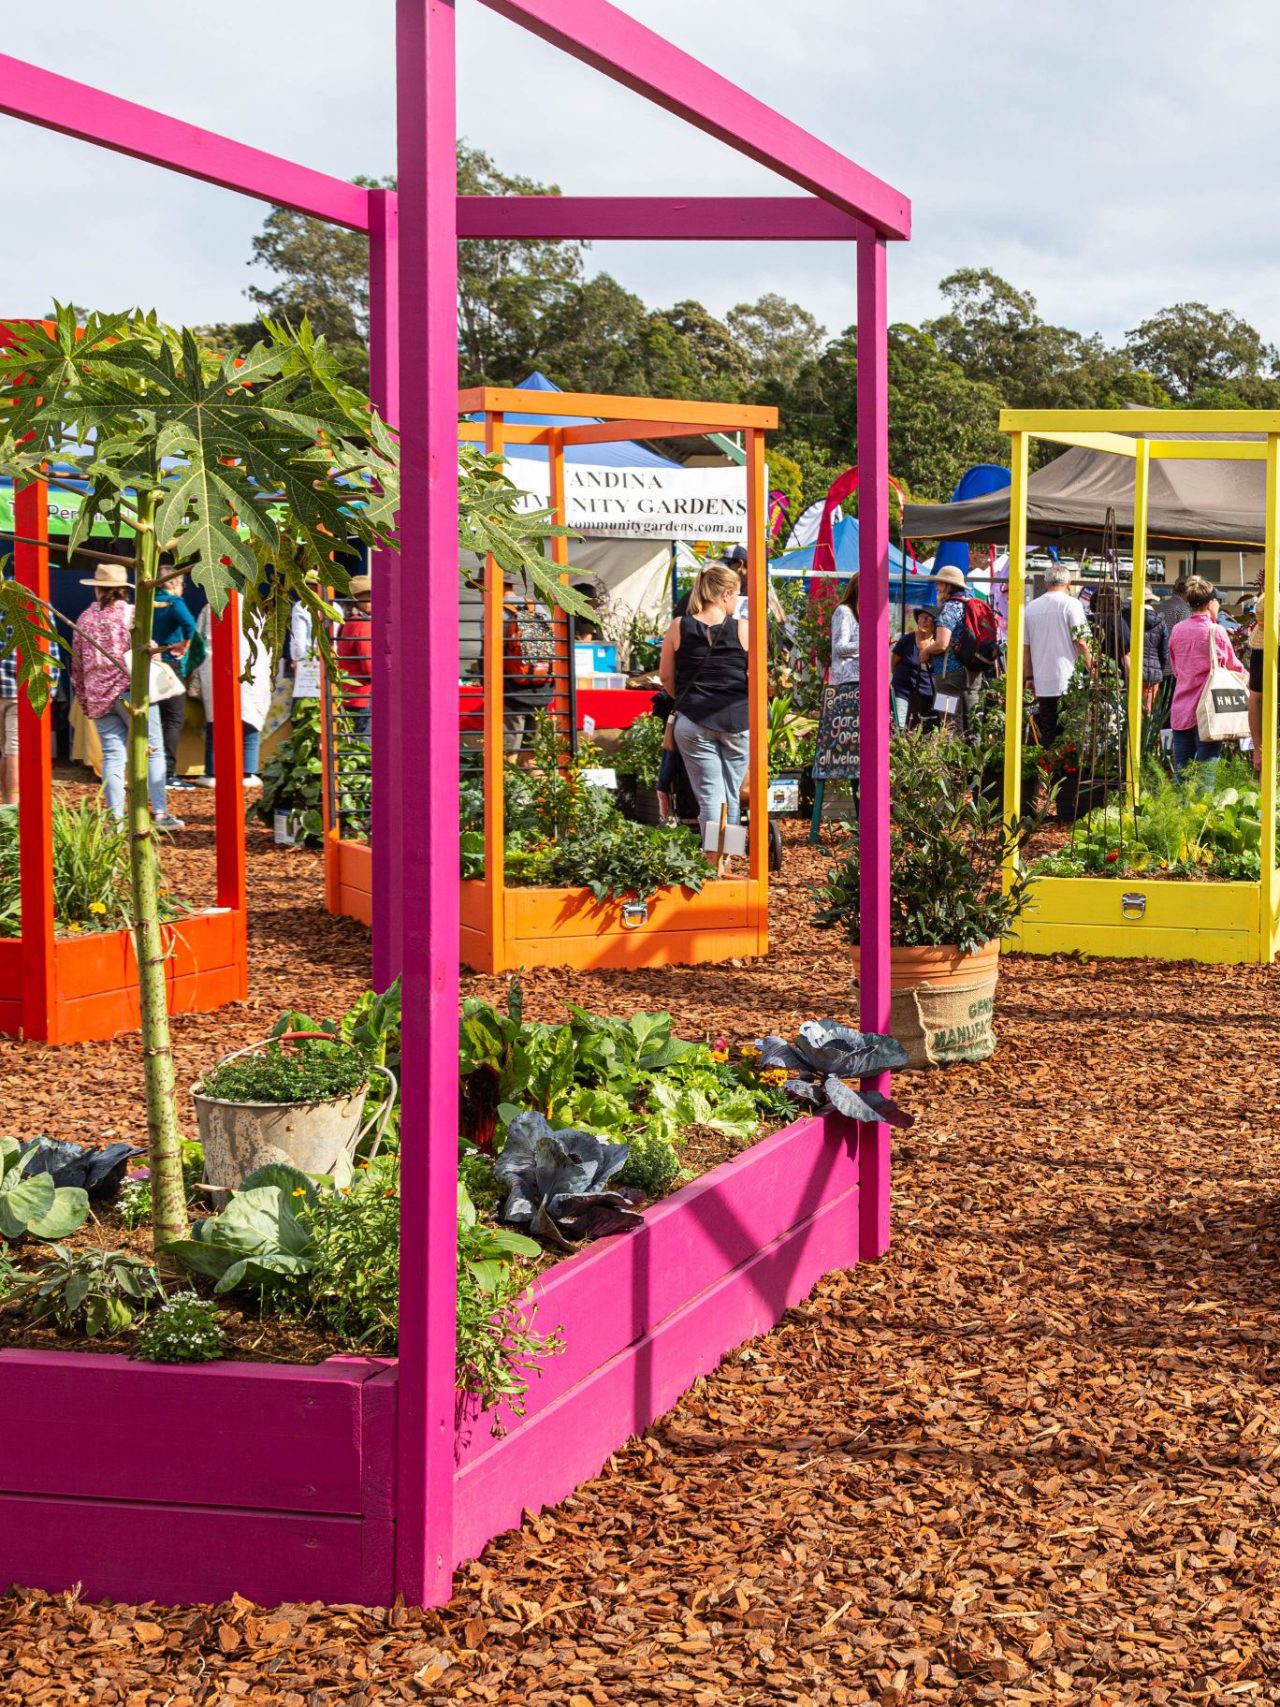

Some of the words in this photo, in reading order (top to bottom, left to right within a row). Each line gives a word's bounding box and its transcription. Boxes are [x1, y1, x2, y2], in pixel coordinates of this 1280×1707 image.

[566, 470, 663, 489] ANDINA
[637, 497, 747, 516] GARDENS
[822, 688, 860, 717] Permac
[1216, 695, 1246, 706] HNLY
[831, 716, 860, 738] gard
[839, 731, 860, 744] ope
[833, 751, 860, 764] welco
